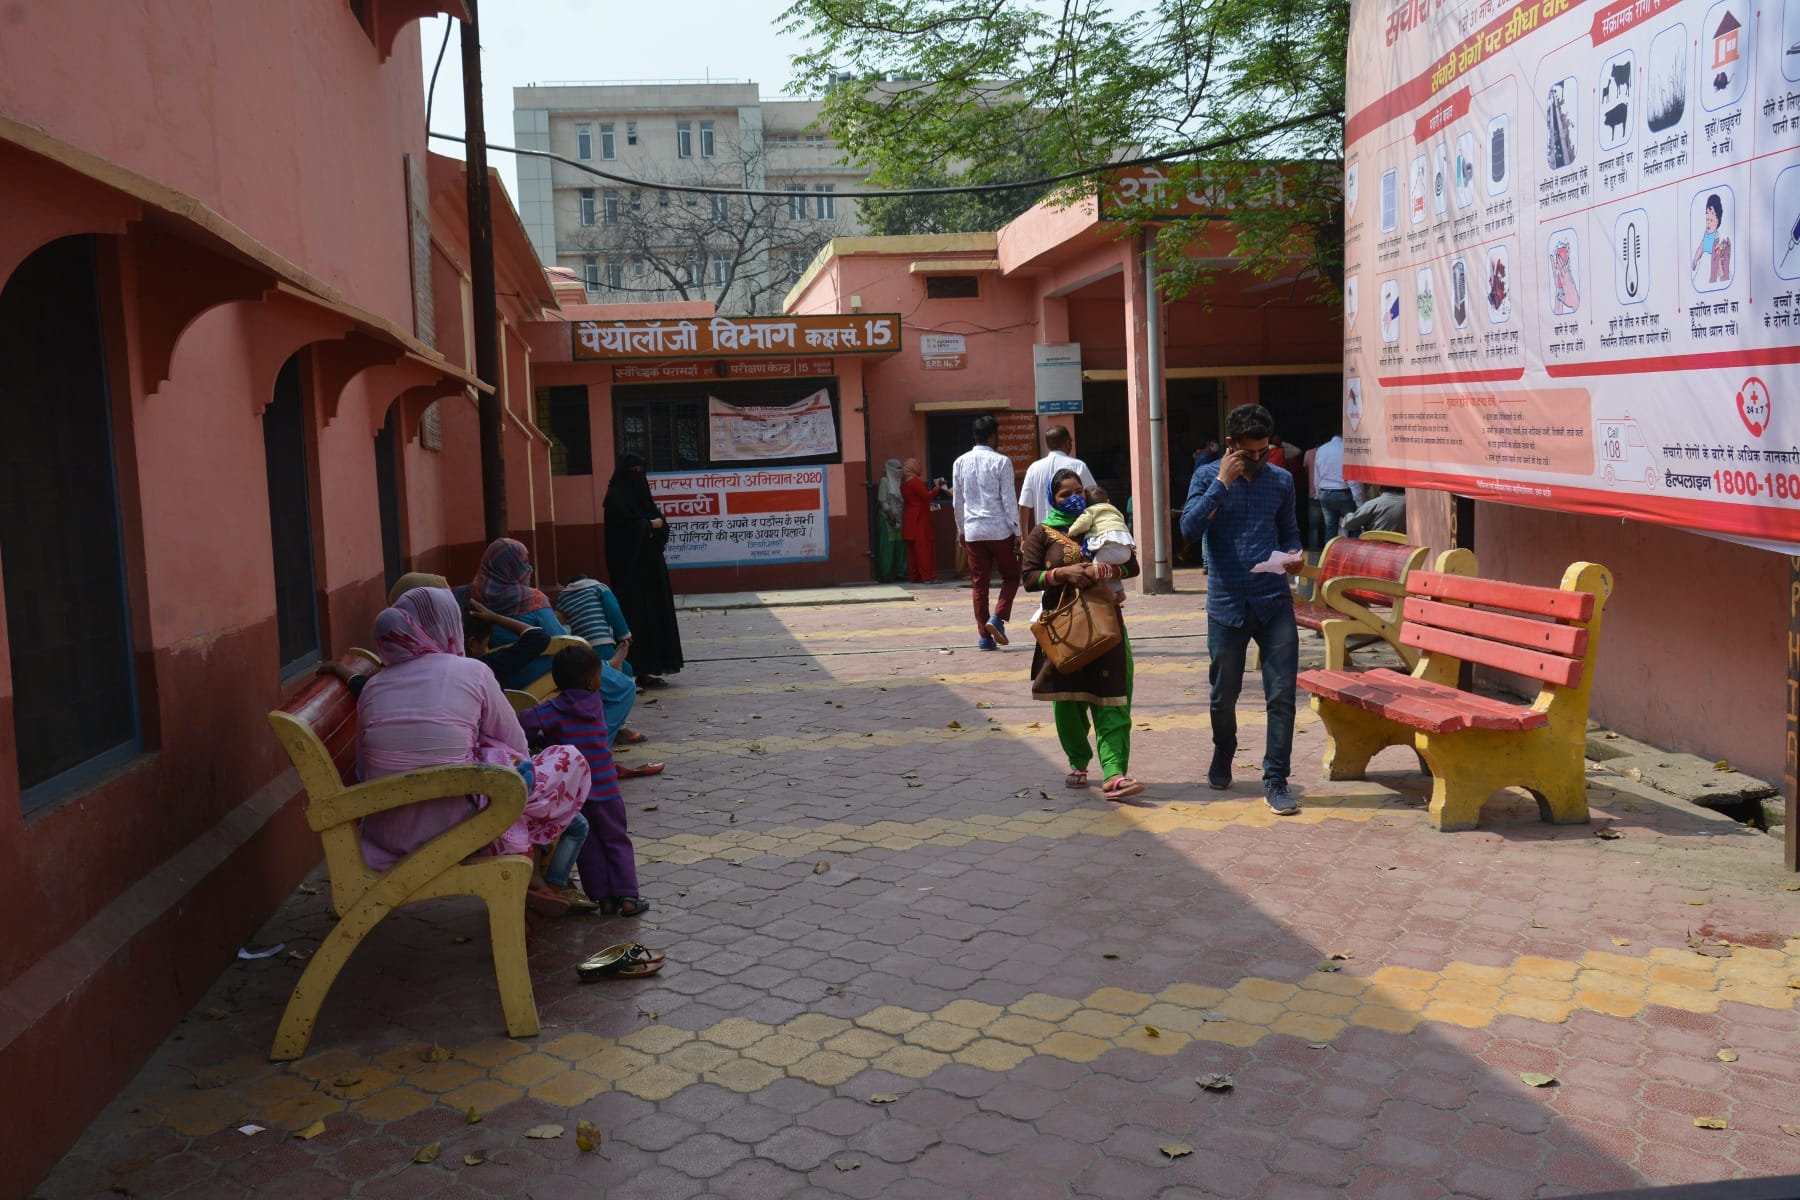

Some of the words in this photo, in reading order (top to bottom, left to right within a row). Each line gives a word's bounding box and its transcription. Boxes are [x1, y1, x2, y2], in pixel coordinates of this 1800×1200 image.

[1432, 52, 1456, 92] संचारी
[1459, 32, 1484, 73] रोगों
[1485, 27, 1502, 53] पर
[1505, 5, 1540, 44] सीधा
[1763, 99, 1776, 117] पीने
[1778, 95, 1785, 112] के
[1772, 115, 1788, 135] पानी
[577, 320, 698, 353] पैथोलॉजी
[708, 317, 797, 350] विभाग
[864, 320, 892, 346] 15
[1607, 427, 1619, 439] Call
[1603, 440, 1621, 459] 108
[1662, 443, 1682, 459] संचारी
[1684, 444, 1700, 459] रोगों
[1702, 444, 1709, 459] के
[1711, 445, 1725, 461] बारे
[1737, 444, 1760, 461] अधिक
[1763, 446, 1800, 464] जानकारी
[660, 477, 692, 489] पल्स
[695, 473, 740, 488] पोलियो
[1713, 469, 1800, 500] 1800-180
[691, 521, 709, 530] तक
[711, 518, 724, 529] के
[726, 516, 749, 529] अपने
[793, 512, 814, 525] सभी
[679, 530, 714, 542] पोलियो
[715, 530, 728, 541] की
